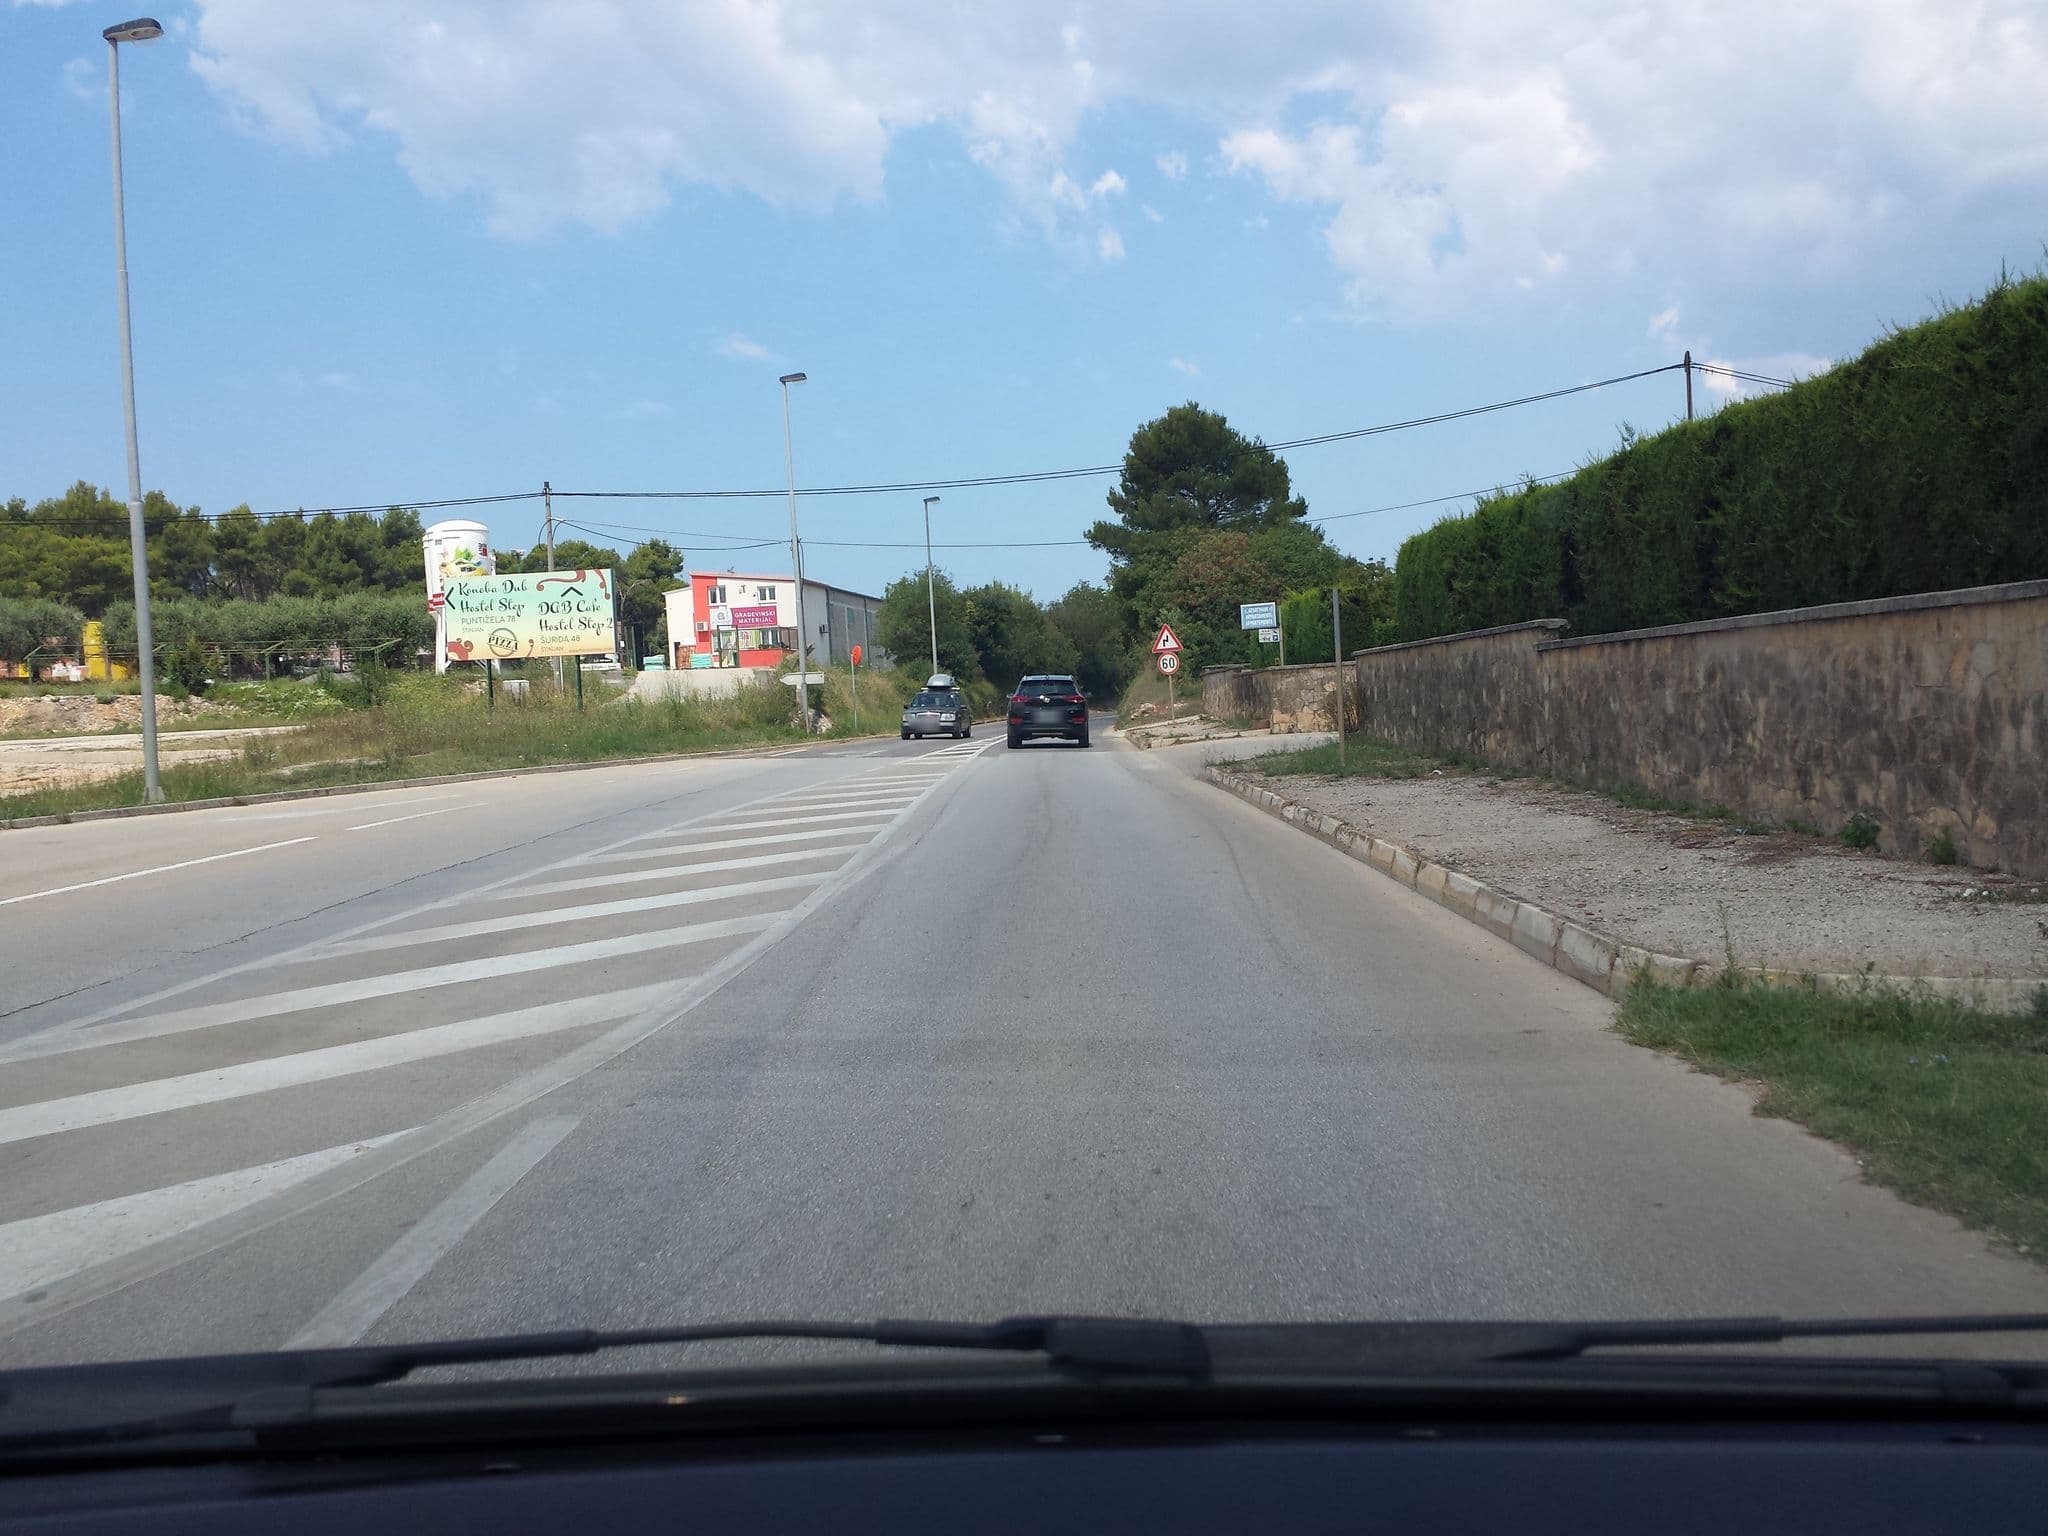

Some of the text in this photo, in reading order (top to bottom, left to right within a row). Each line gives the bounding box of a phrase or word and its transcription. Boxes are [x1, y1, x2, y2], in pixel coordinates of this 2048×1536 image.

[458, 581, 499, 597] Konoba
[460, 598, 494, 613] Hostel
[539, 616, 573, 632] Hostel
[606, 617, 614, 629] 2
[488, 636, 518, 651] PIZZA
[1161, 657, 1175, 670] 60
